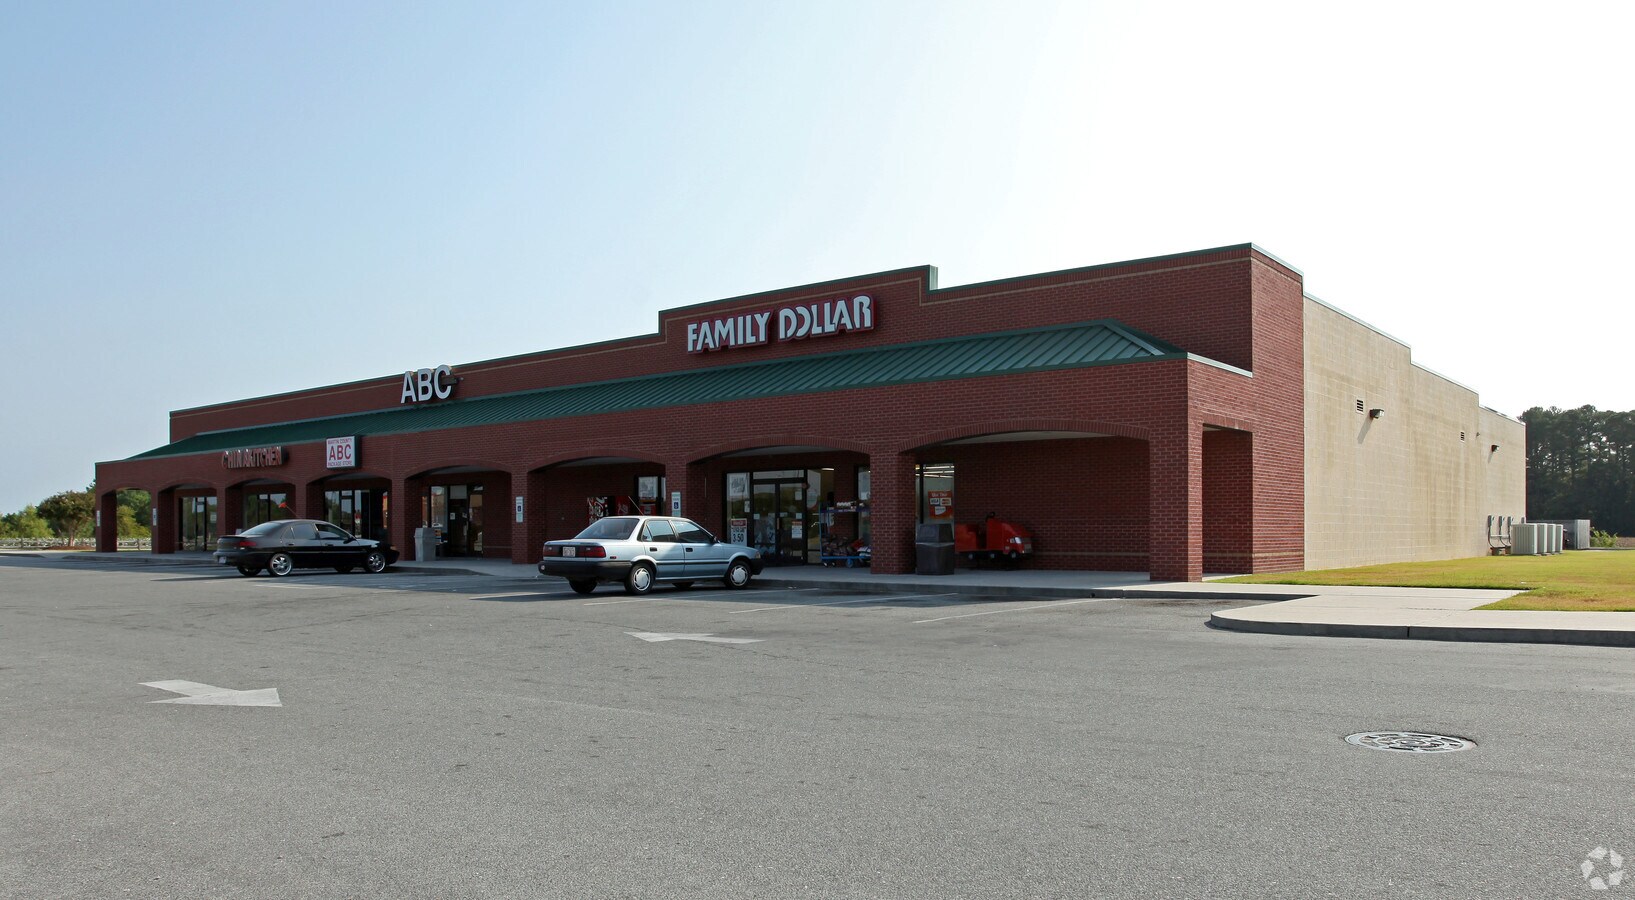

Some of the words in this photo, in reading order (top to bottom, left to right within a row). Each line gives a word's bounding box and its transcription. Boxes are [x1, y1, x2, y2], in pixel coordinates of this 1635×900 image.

[687, 311, 771, 352] FAMILY
[779, 295, 872, 340] DOLLAR
[401, 365, 452, 403] ABC
[329, 443, 352, 461] ABC
